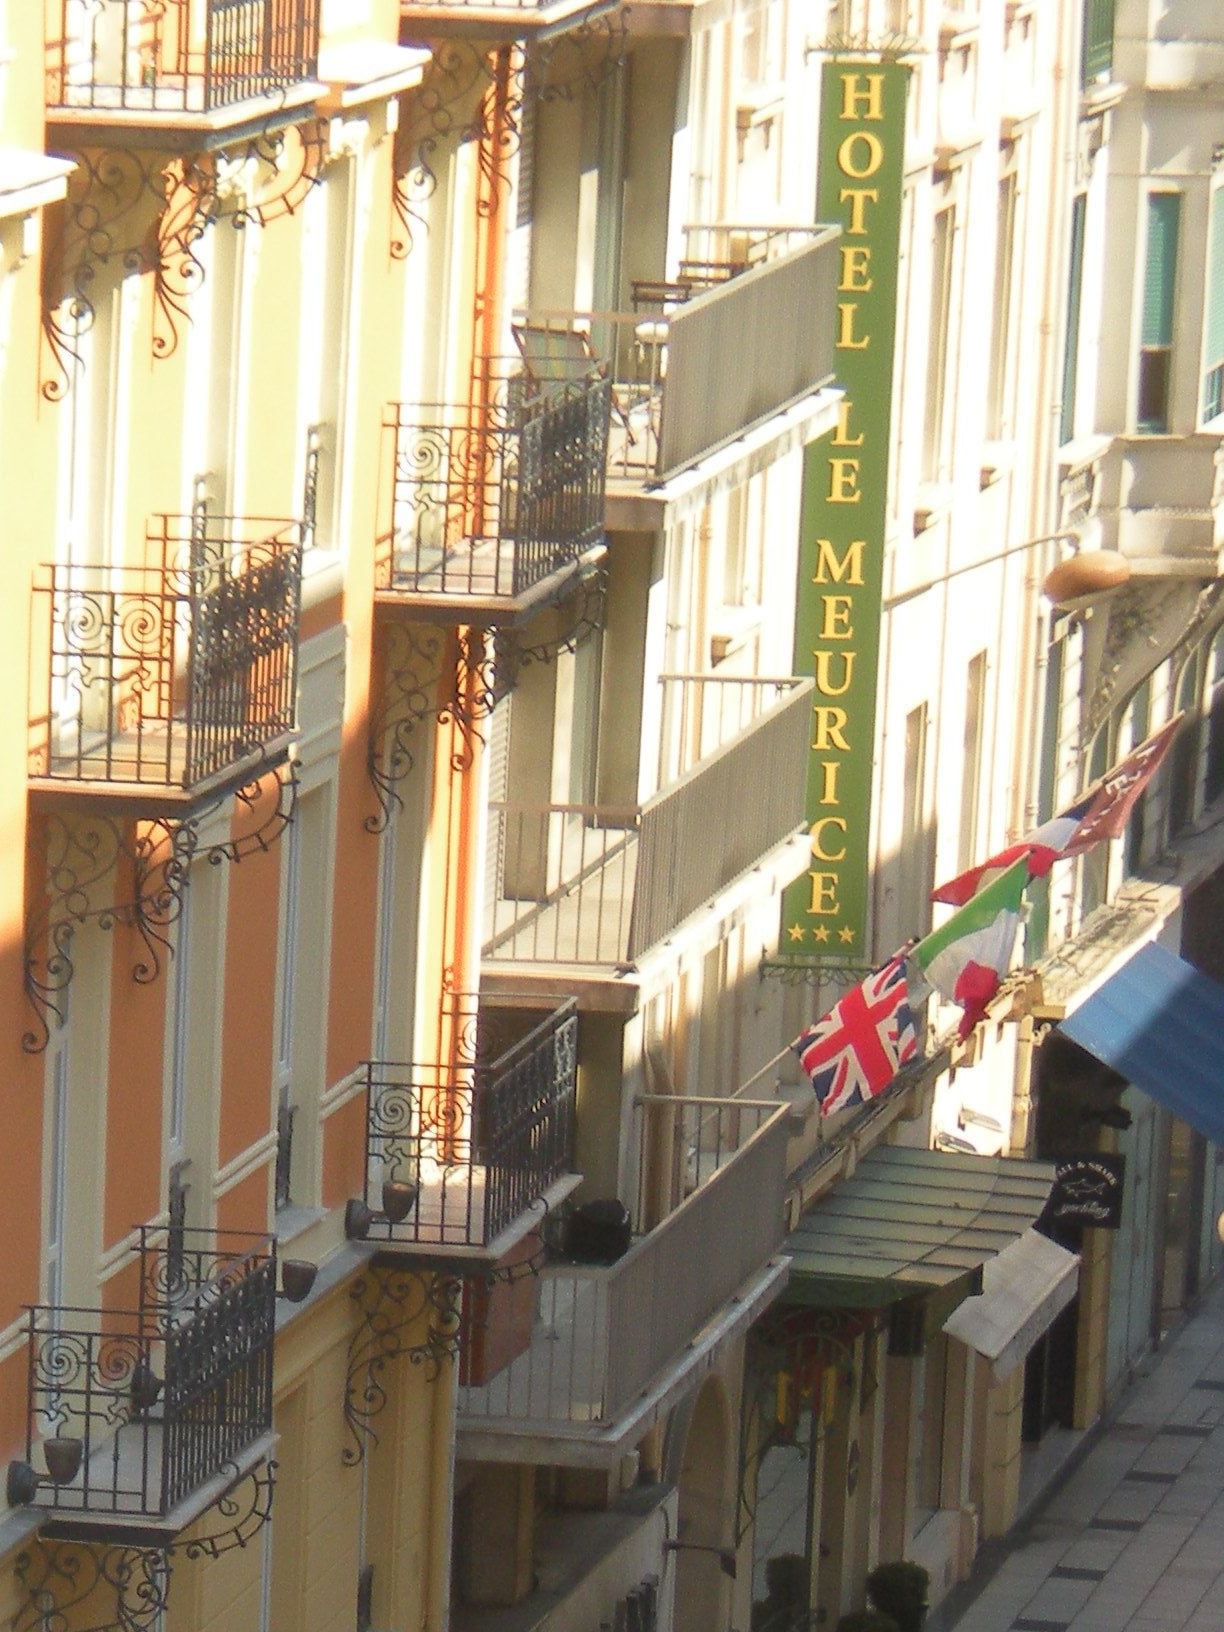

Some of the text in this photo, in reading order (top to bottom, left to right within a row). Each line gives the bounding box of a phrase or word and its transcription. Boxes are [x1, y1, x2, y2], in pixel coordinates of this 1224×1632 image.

[806, 73, 886, 916] HOTEL LE MEURICE
